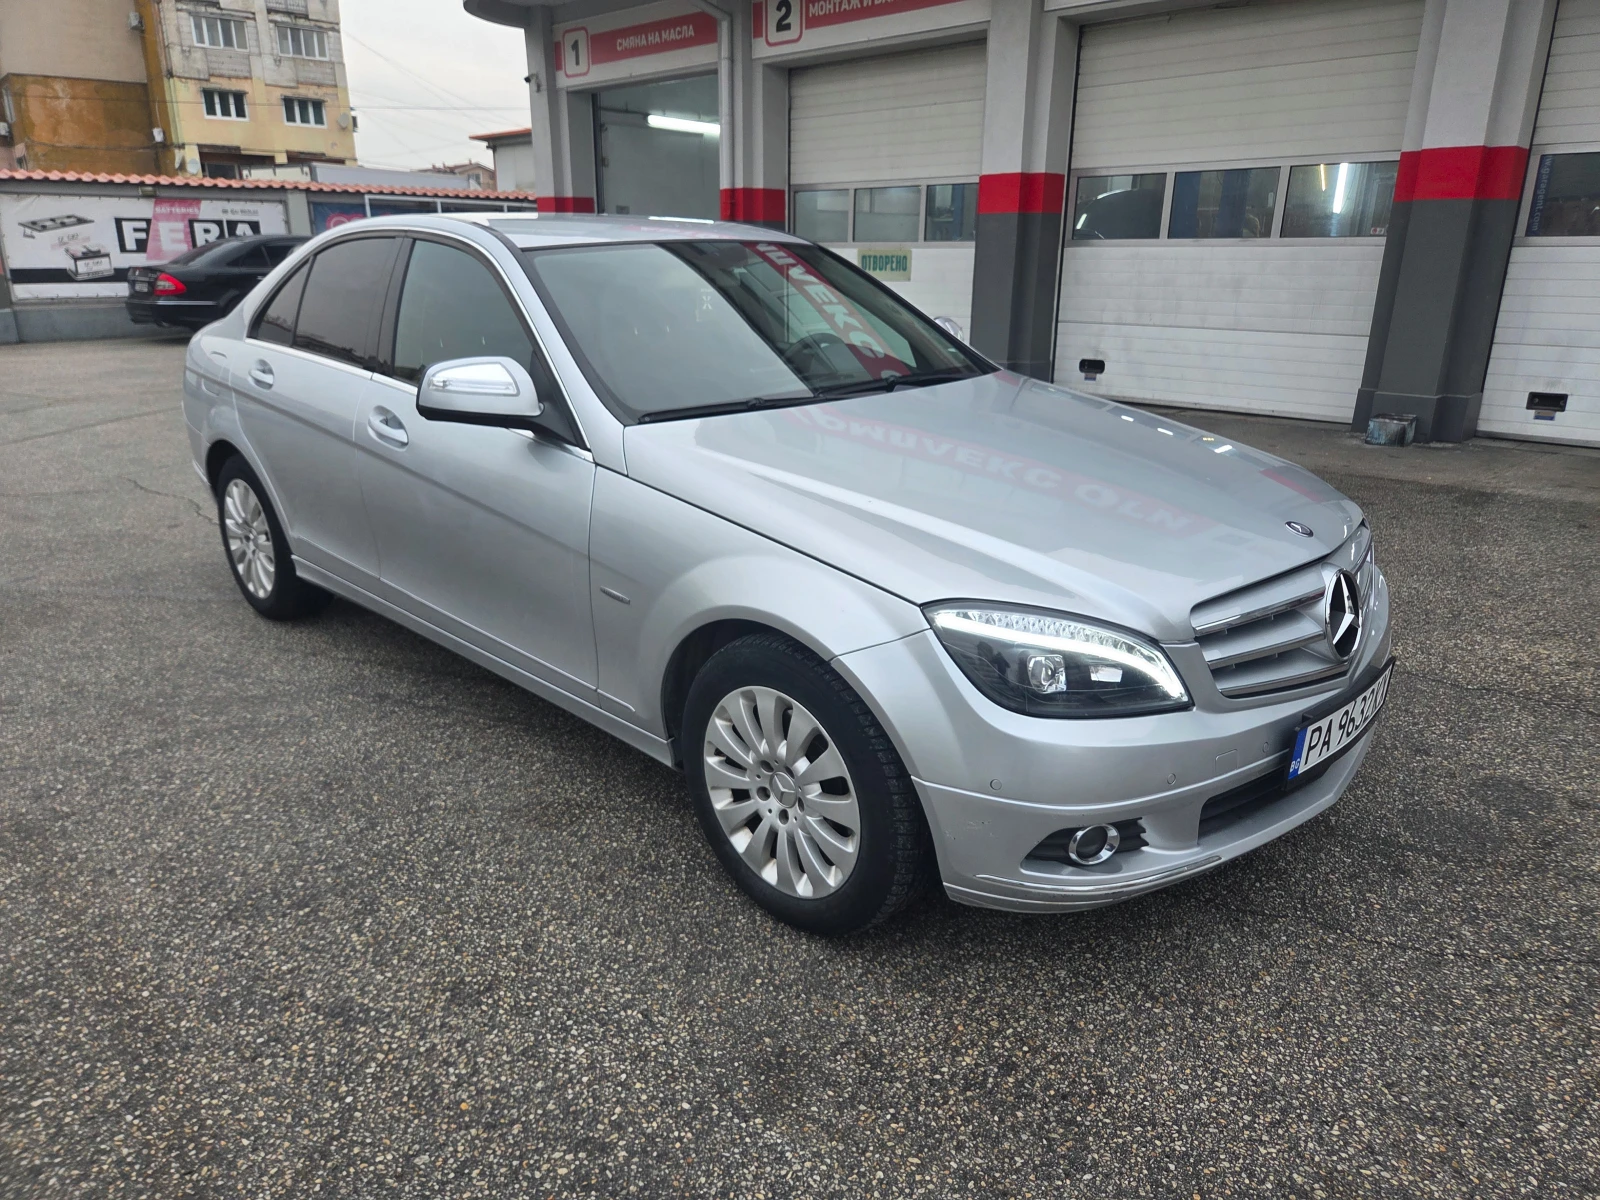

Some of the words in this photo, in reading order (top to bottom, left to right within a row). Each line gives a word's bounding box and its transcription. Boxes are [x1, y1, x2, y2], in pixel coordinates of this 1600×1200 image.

[775, 0, 792, 33] 2
[809, 0, 861, 17] МОНТАЖ
[616, 34, 647, 52] СМЯНА
[648, 32, 661, 46] НА
[662, 24, 695, 43] МАСЛА
[571, 39, 580, 66] 1
[861, 255, 908, 271] ОТВОРЕНО
[1304, 718, 1333, 766] PA
[1336, 687, 1376, 746] 9632
[1290, 758, 1301, 772] BG
